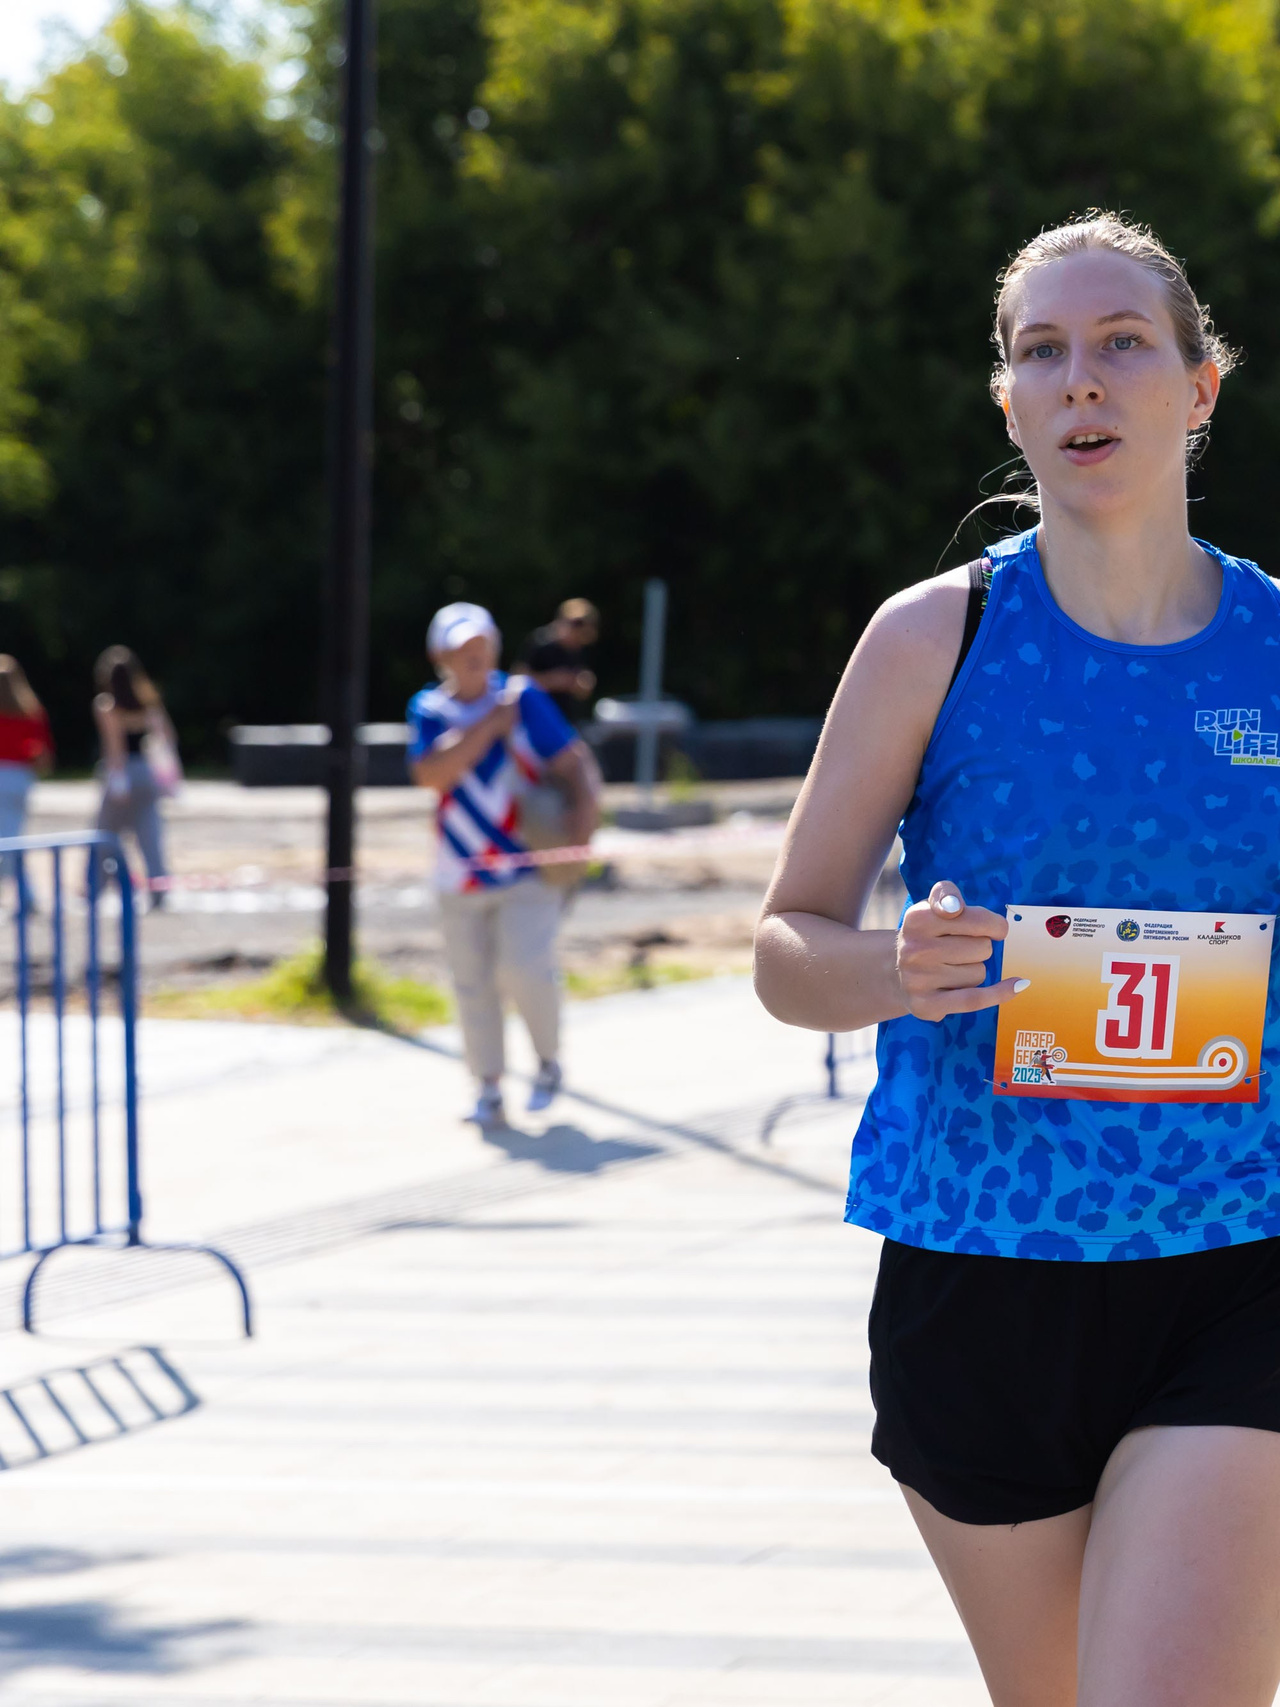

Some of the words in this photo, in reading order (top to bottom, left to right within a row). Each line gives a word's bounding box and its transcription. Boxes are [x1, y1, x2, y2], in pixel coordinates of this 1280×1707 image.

[1195, 709, 1261, 733] RUN
[1214, 730, 1278, 757] LIFE
[1104, 961, 1171, 1051] 31
[1016, 1032, 1054, 1048] ЛАЗЕР
[1013, 1067, 1042, 1083] 2025
